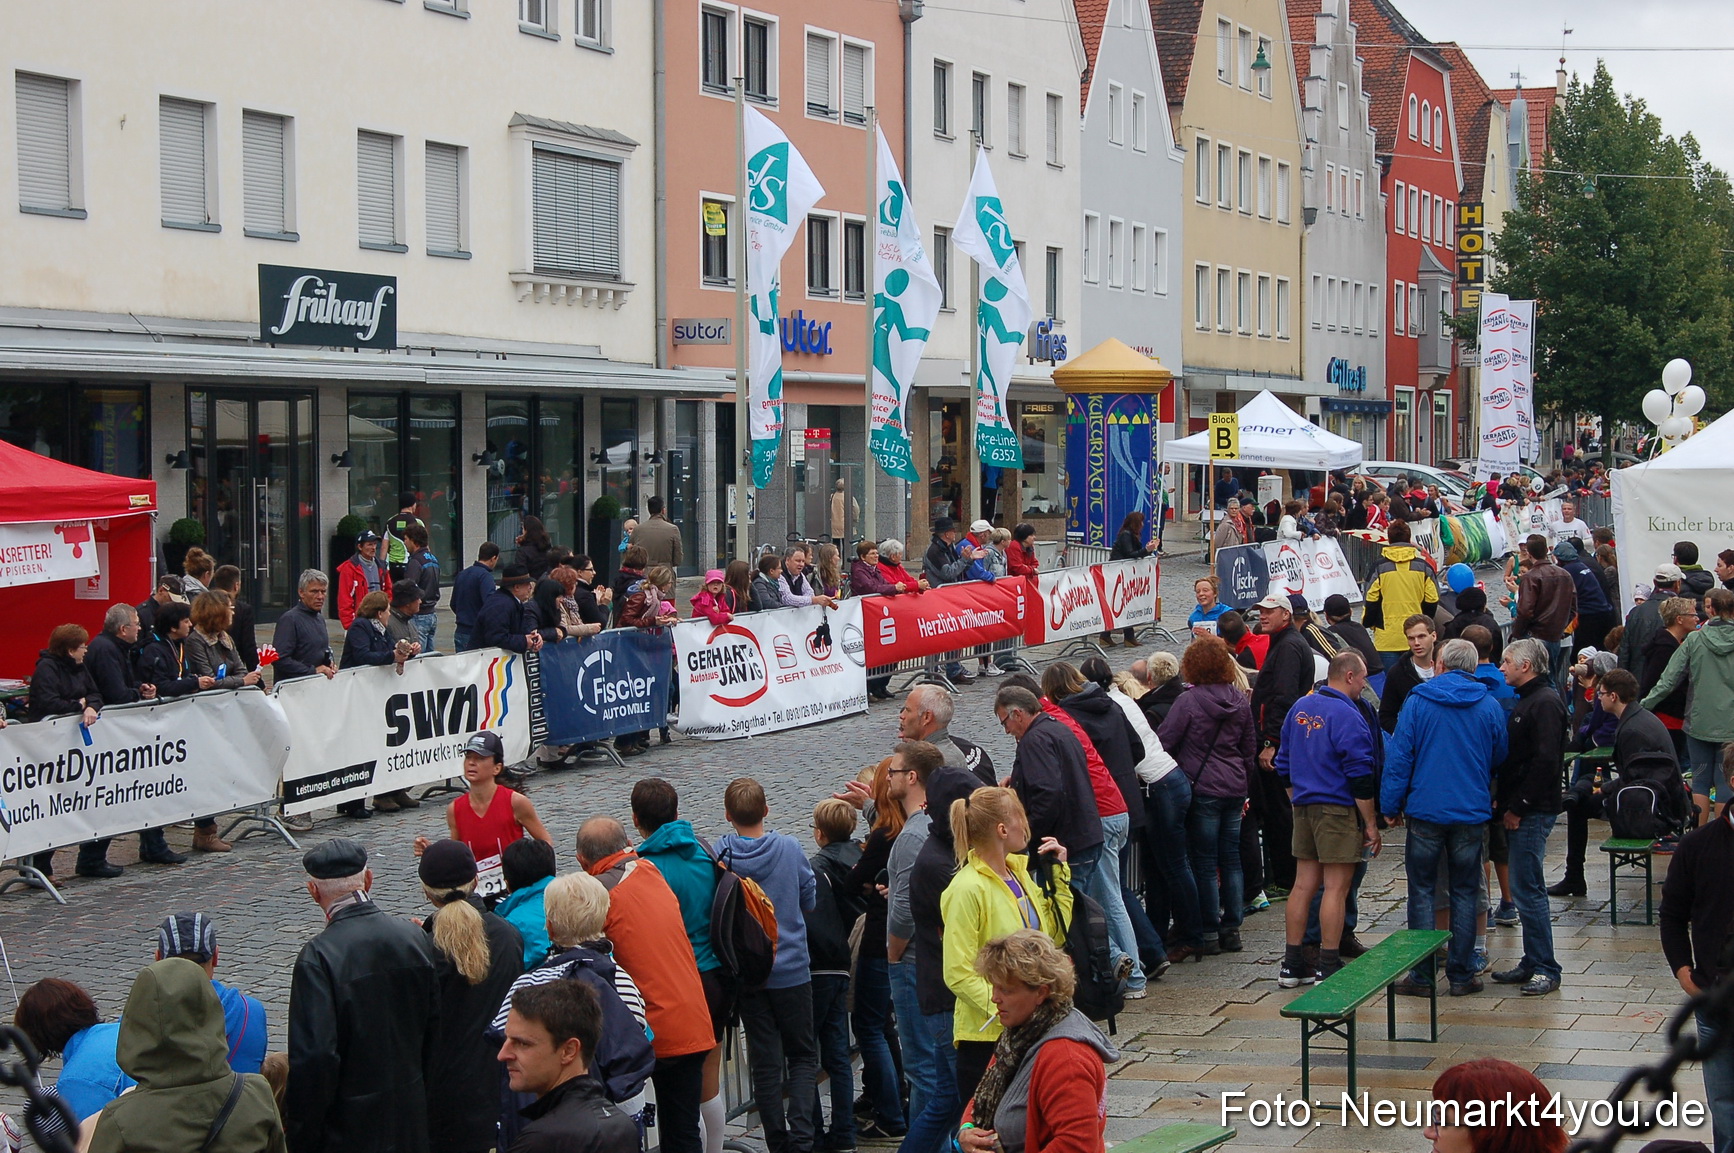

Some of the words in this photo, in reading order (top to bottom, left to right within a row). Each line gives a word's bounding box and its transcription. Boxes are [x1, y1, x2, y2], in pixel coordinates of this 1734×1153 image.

[271, 274, 395, 341] frühauf
[779, 309, 833, 355] utor.
[1036, 318, 1067, 361] fries
[1024, 404, 1055, 412] FRIES
[1211, 415, 1236, 424] Block
[1216, 427, 1232, 450] B
[991, 448, 1017, 462] 6352
[1647, 516, 1704, 532] Kinder
[916, 612, 956, 638] Herzlich
[956, 608, 1005, 631] willkommen
[687, 643, 748, 672] GERHART
[775, 670, 807, 685] SEAT
[49, 791, 92, 818] Mehr
[94, 773, 188, 809] Fahrfreude.
